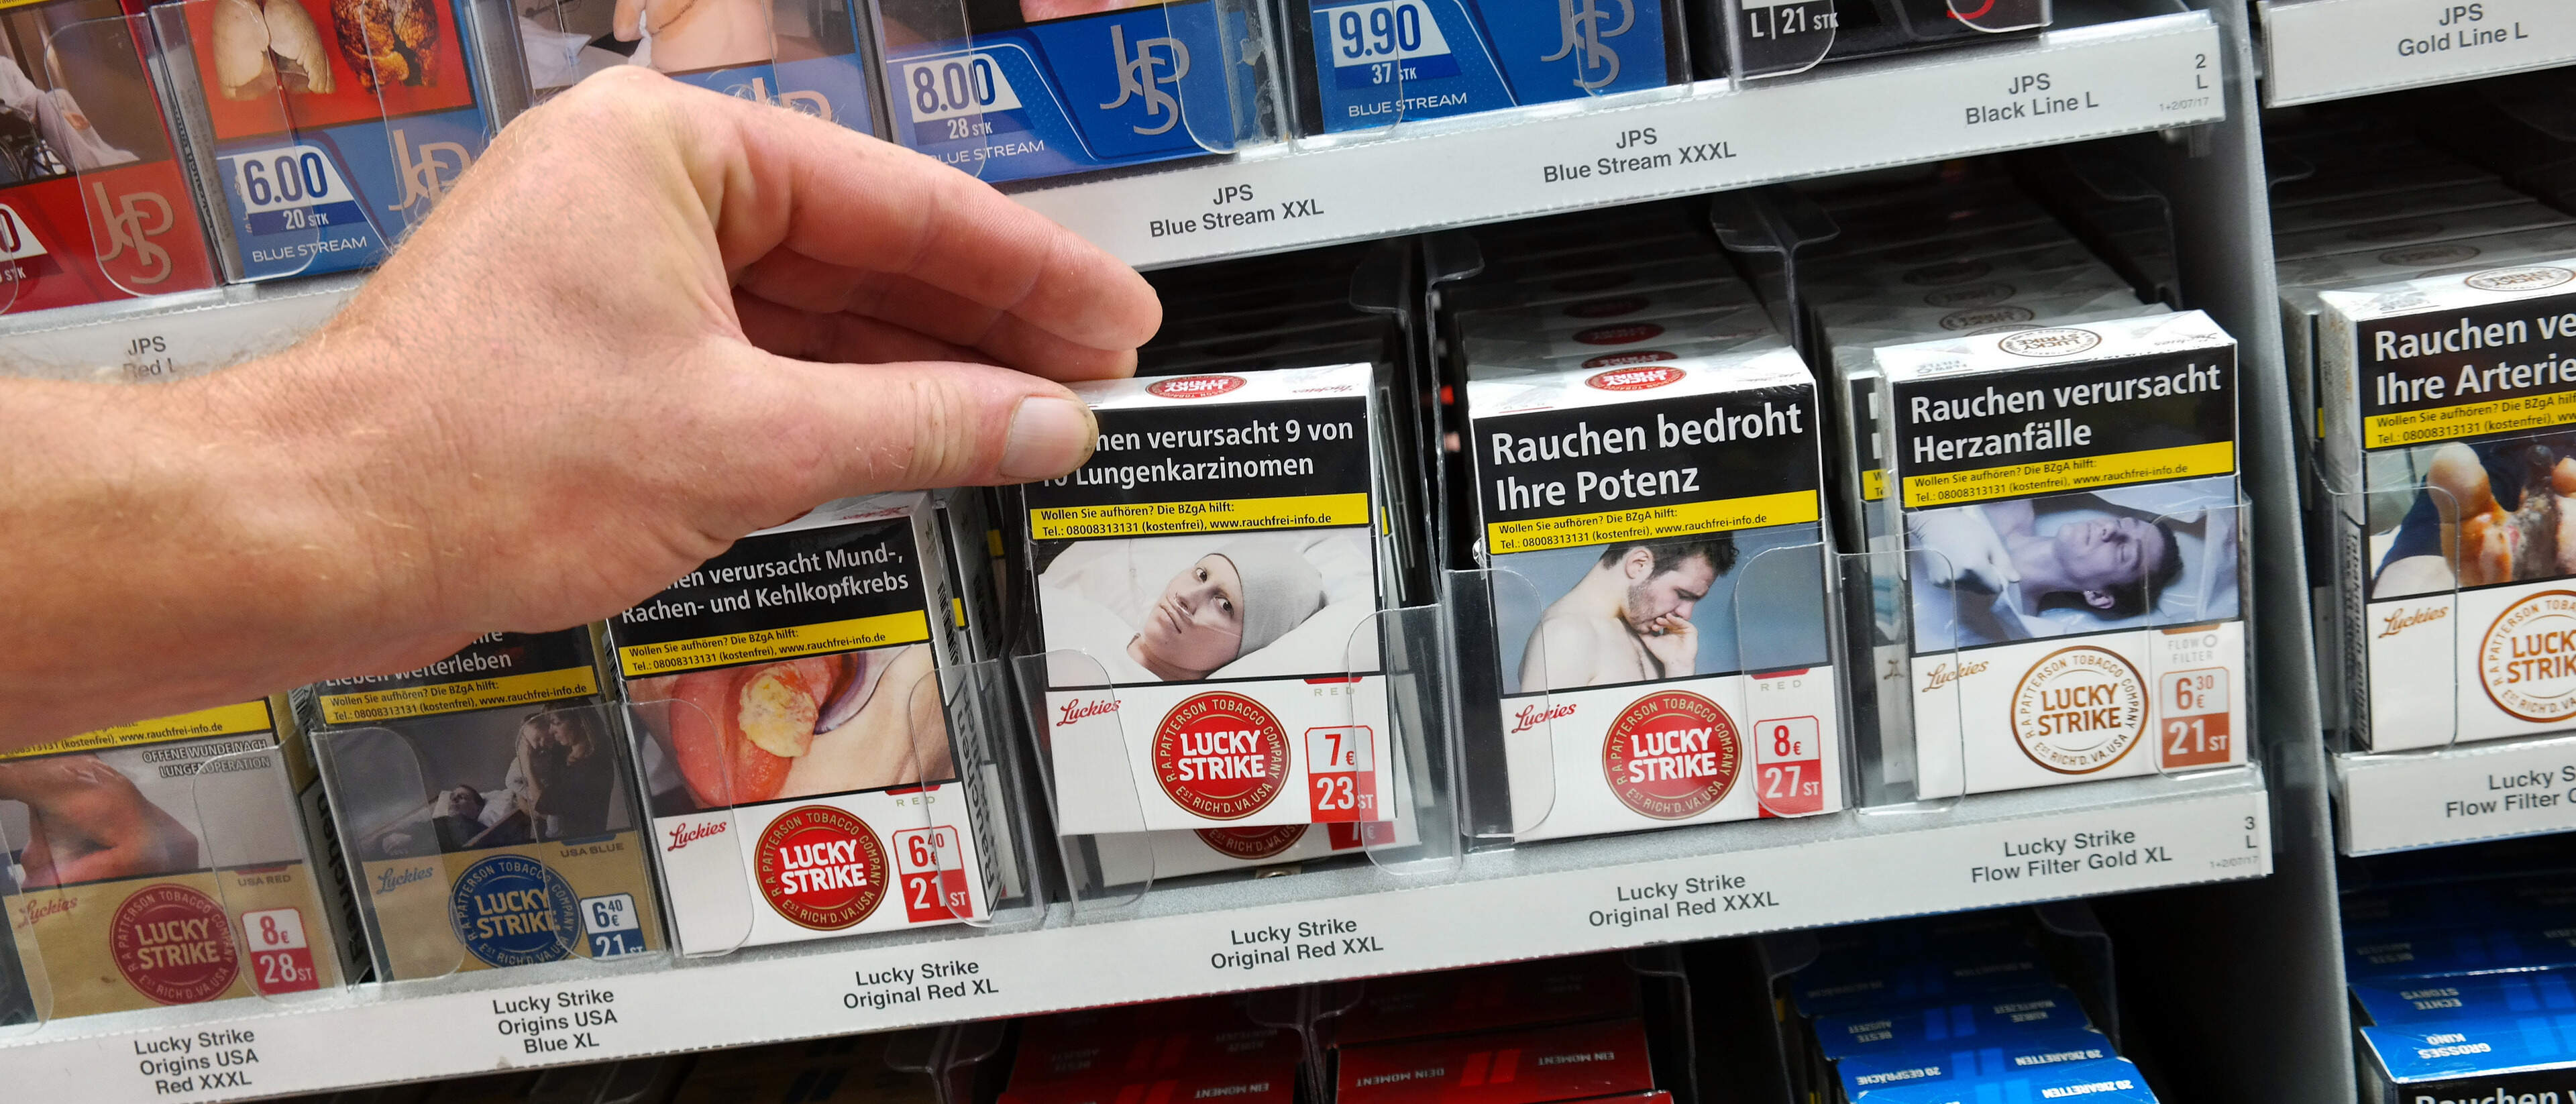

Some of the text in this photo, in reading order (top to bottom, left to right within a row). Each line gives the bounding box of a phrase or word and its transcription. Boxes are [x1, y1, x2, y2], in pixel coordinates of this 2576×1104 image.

[1750, 6, 1838, 38] L 21 STK
[2438, 3, 2483, 26] JPS
[1341, 4, 1421, 58] 9.90
[2398, 21, 2528, 58] Gold Line L
[1372, 64, 1417, 84] 37 STK
[2195, 54, 2206, 70] 2
[913, 53, 995, 114] 8.00
[2008, 73, 2051, 95] JPS
[2196, 74, 2208, 90] L
[1348, 92, 1468, 117] BLUE STREAM
[1965, 91, 2099, 125] Black Line L
[947, 119, 993, 140] 28 STK
[1615, 127, 1658, 150] JPS
[973, 141, 1044, 161] STREAM
[1543, 142, 1737, 184] Blue Stream XXXL
[244, 151, 328, 205] 6.00
[1212, 184, 1254, 205] JPS
[282, 209, 329, 230] 20 STK
[1150, 199, 1324, 238] Blue Stream XXL
[252, 237, 368, 263] BLUE STREAM
[127, 335, 167, 356] JPS
[2375, 317, 2527, 362] Rauchen
[1911, 364, 2221, 425] Rauchen verursacht
[2376, 374, 2446, 406] Ihre
[1147, 421, 1279, 450] verursacht
[1285, 419, 1300, 441] 9
[1307, 421, 1353, 440] von
[1493, 402, 1803, 465] Rauchen bedroht
[1914, 420, 2091, 463] Herzanfälle
[1077, 457, 1313, 490] Lungenkarzinomen
[1496, 468, 1699, 511] Ihre Potenz
[1041, 501, 1234, 520] Wollen Sie aufhören? Die BZgA hilft:
[1042, 513, 1332, 537] Tel.: 08008313131 (kostenfrei), www.rauchfrei-info.de
[1499, 508, 1678, 535] Wollen Sie aufhören? Die BZgA hilft:
[1501, 514, 1767, 549] Tel.: 08008313131 (kostenfrei), www.rauchfrei-info.de
[709, 552, 822, 586] verursacht
[826, 543, 904, 571] Mund-,
[622, 572, 908, 624] Rachen- und Kehlkopfkrebs
[2377, 605, 2449, 639] Luckies
[1923, 659, 1990, 692] Luckies
[1057, 698, 1121, 726] Luckies
[2041, 683, 2118, 712] LUCKY
[1511, 702, 1576, 734] Luckies
[2038, 707, 2122, 736] STRIKE
[143, 739, 268, 763] OFFENE WUNDE NACH
[1180, 730, 1261, 756] LUCKY
[1212, 699, 1281, 779] TOBACCO COMPANY
[1631, 727, 1713, 757] LUCKY
[2168, 720, 2227, 756] 21 ST
[1179, 755, 1266, 781] STRIKE
[1629, 753, 1717, 783] STRIKE
[1765, 765, 1819, 799] 27 ST
[2489, 770, 2555, 791] Lucky
[1317, 777, 1374, 810] 23 ST
[2447, 791, 2561, 818] Flow Filter
[667, 821, 727, 852] Luckies
[2245, 816, 2255, 832] 3
[780, 840, 861, 869] LUCKY
[2004, 830, 2135, 859] Lucky Strike
[2247, 835, 2257, 850] L
[1972, 845, 2173, 883] Flow Filter Gold XL
[781, 863, 867, 895] STRIKE
[1617, 875, 1746, 902] Lucky Strike
[474, 888, 548, 916] LUCKY
[1589, 892, 1779, 928] Original Red XXXL
[135, 918, 209, 946] LUCKY
[476, 909, 560, 938] STRIKE
[1231, 918, 1357, 946] Lucky Strike
[138, 942, 220, 970] STRIKE
[1211, 936, 1384, 970] Original Red XXL
[260, 953, 313, 983] 28 ST
[856, 959, 979, 987] Lucky Strike
[492, 989, 614, 1014] Lucky Strike
[843, 979, 999, 1011] Original Red XL
[498, 1009, 618, 1036] Origins USA
[133, 1029, 254, 1056] Lucky Strike
[524, 1032, 600, 1054] Blue XL
[140, 1049, 259, 1077] Origins USA
[155, 1070, 252, 1095] Red XXXL
